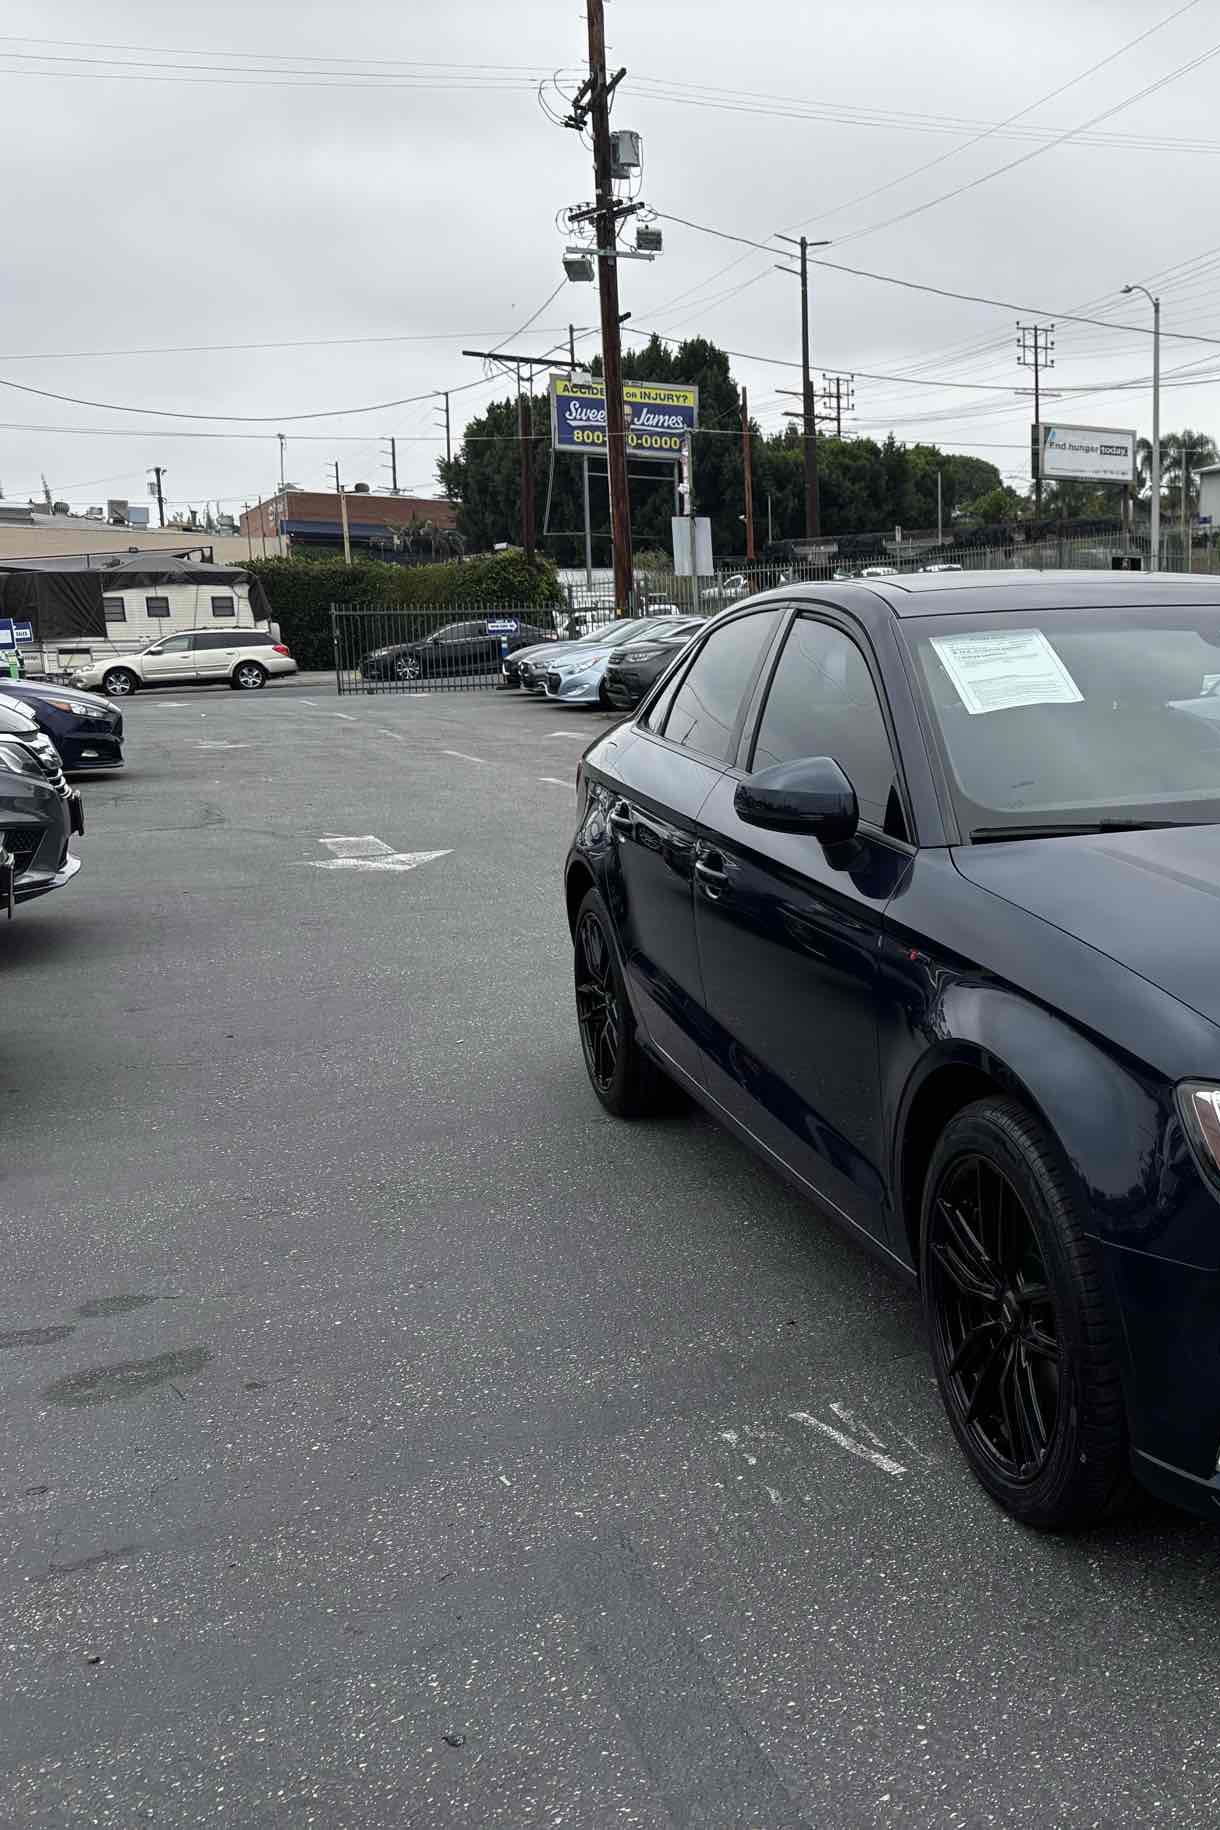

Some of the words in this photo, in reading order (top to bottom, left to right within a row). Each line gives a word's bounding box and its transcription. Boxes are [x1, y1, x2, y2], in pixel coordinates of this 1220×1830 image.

[562, 382, 606, 397] ACCIDE
[639, 391, 688, 405] INJURY?
[565, 400, 607, 423] Swee
[574, 430, 681, 449] 800-0-0000
[1067, 443, 1099, 454] hunger
